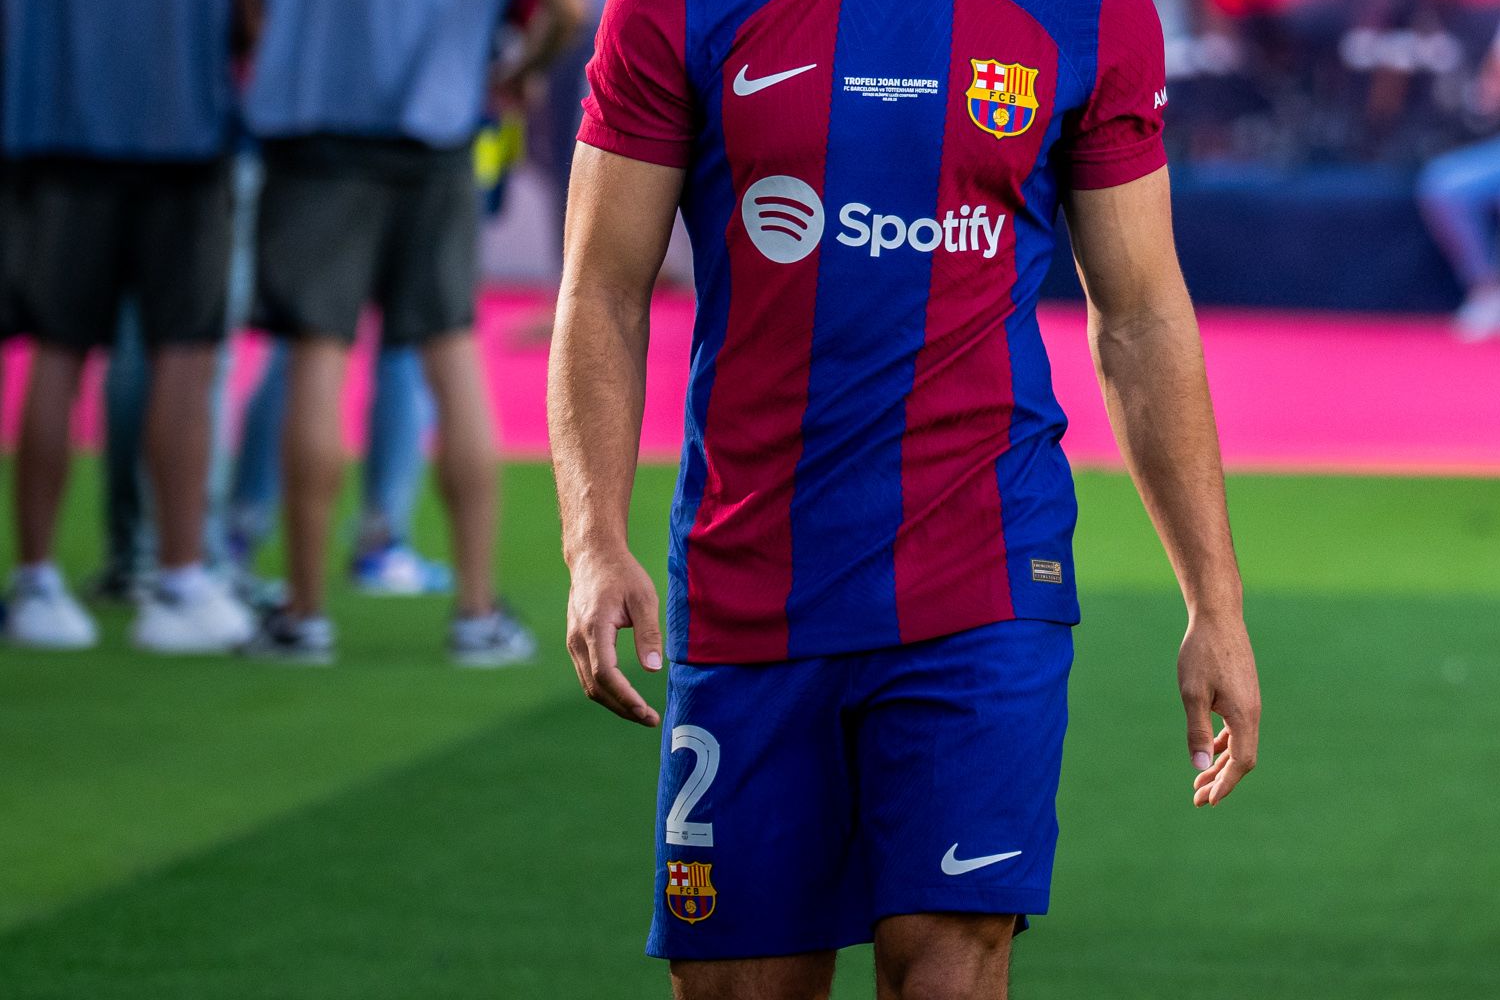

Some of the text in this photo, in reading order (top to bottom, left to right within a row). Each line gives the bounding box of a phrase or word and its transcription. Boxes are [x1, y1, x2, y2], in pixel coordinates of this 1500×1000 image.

[844, 77, 938, 88] TROFEU JOAN GAMPER
[836, 203, 1006, 259] Spotify
[665, 724, 720, 847] 2
